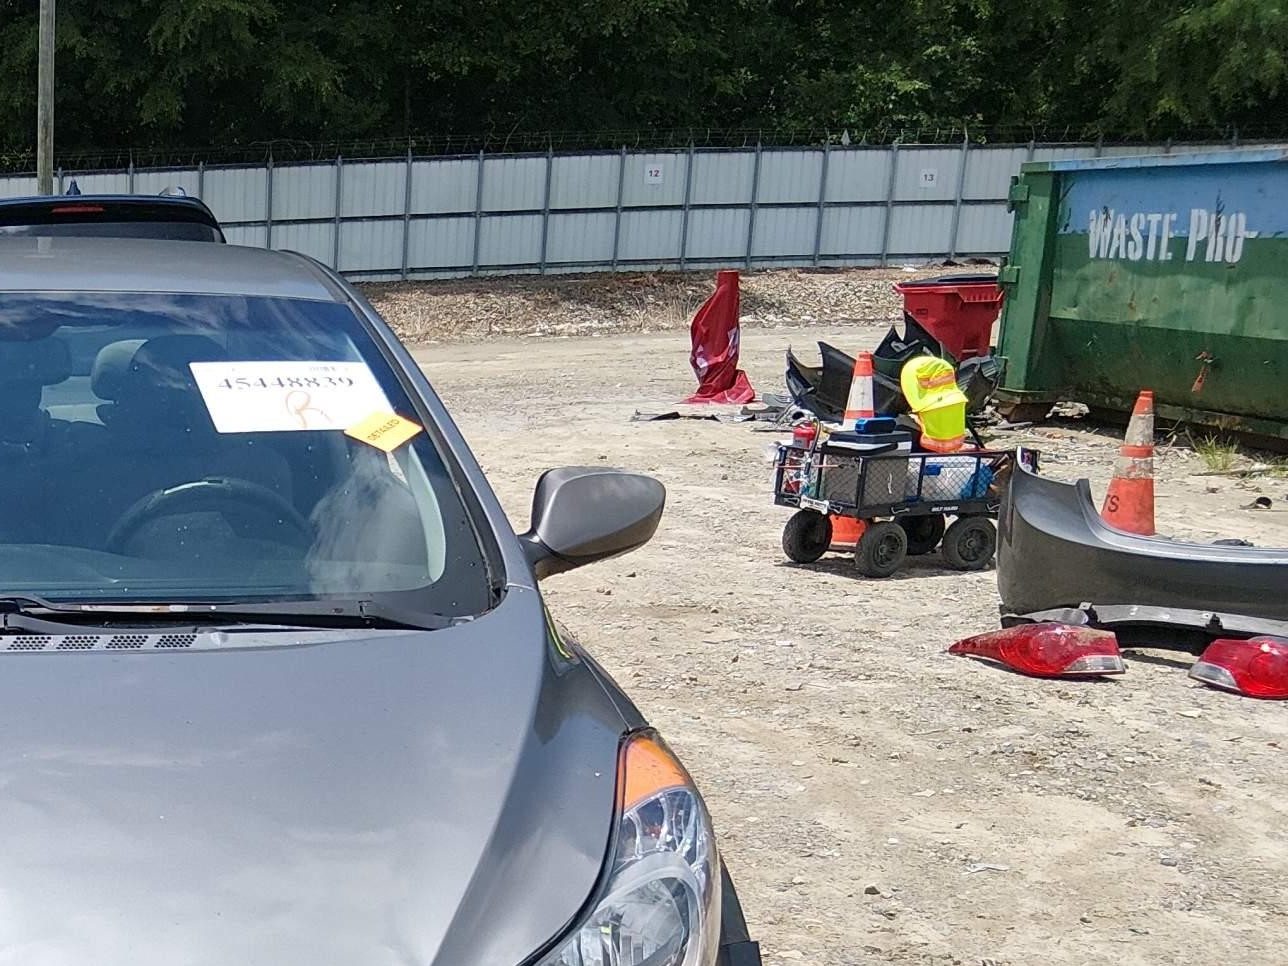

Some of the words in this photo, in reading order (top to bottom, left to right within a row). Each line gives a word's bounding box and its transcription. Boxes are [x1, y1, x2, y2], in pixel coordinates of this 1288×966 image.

[648, 169, 660, 178] 12
[1088, 208, 1178, 261] WASTE
[1185, 208, 1246, 264] PRO
[218, 375, 355, 390] 45448839
[366, 418, 401, 442] DETAILED
